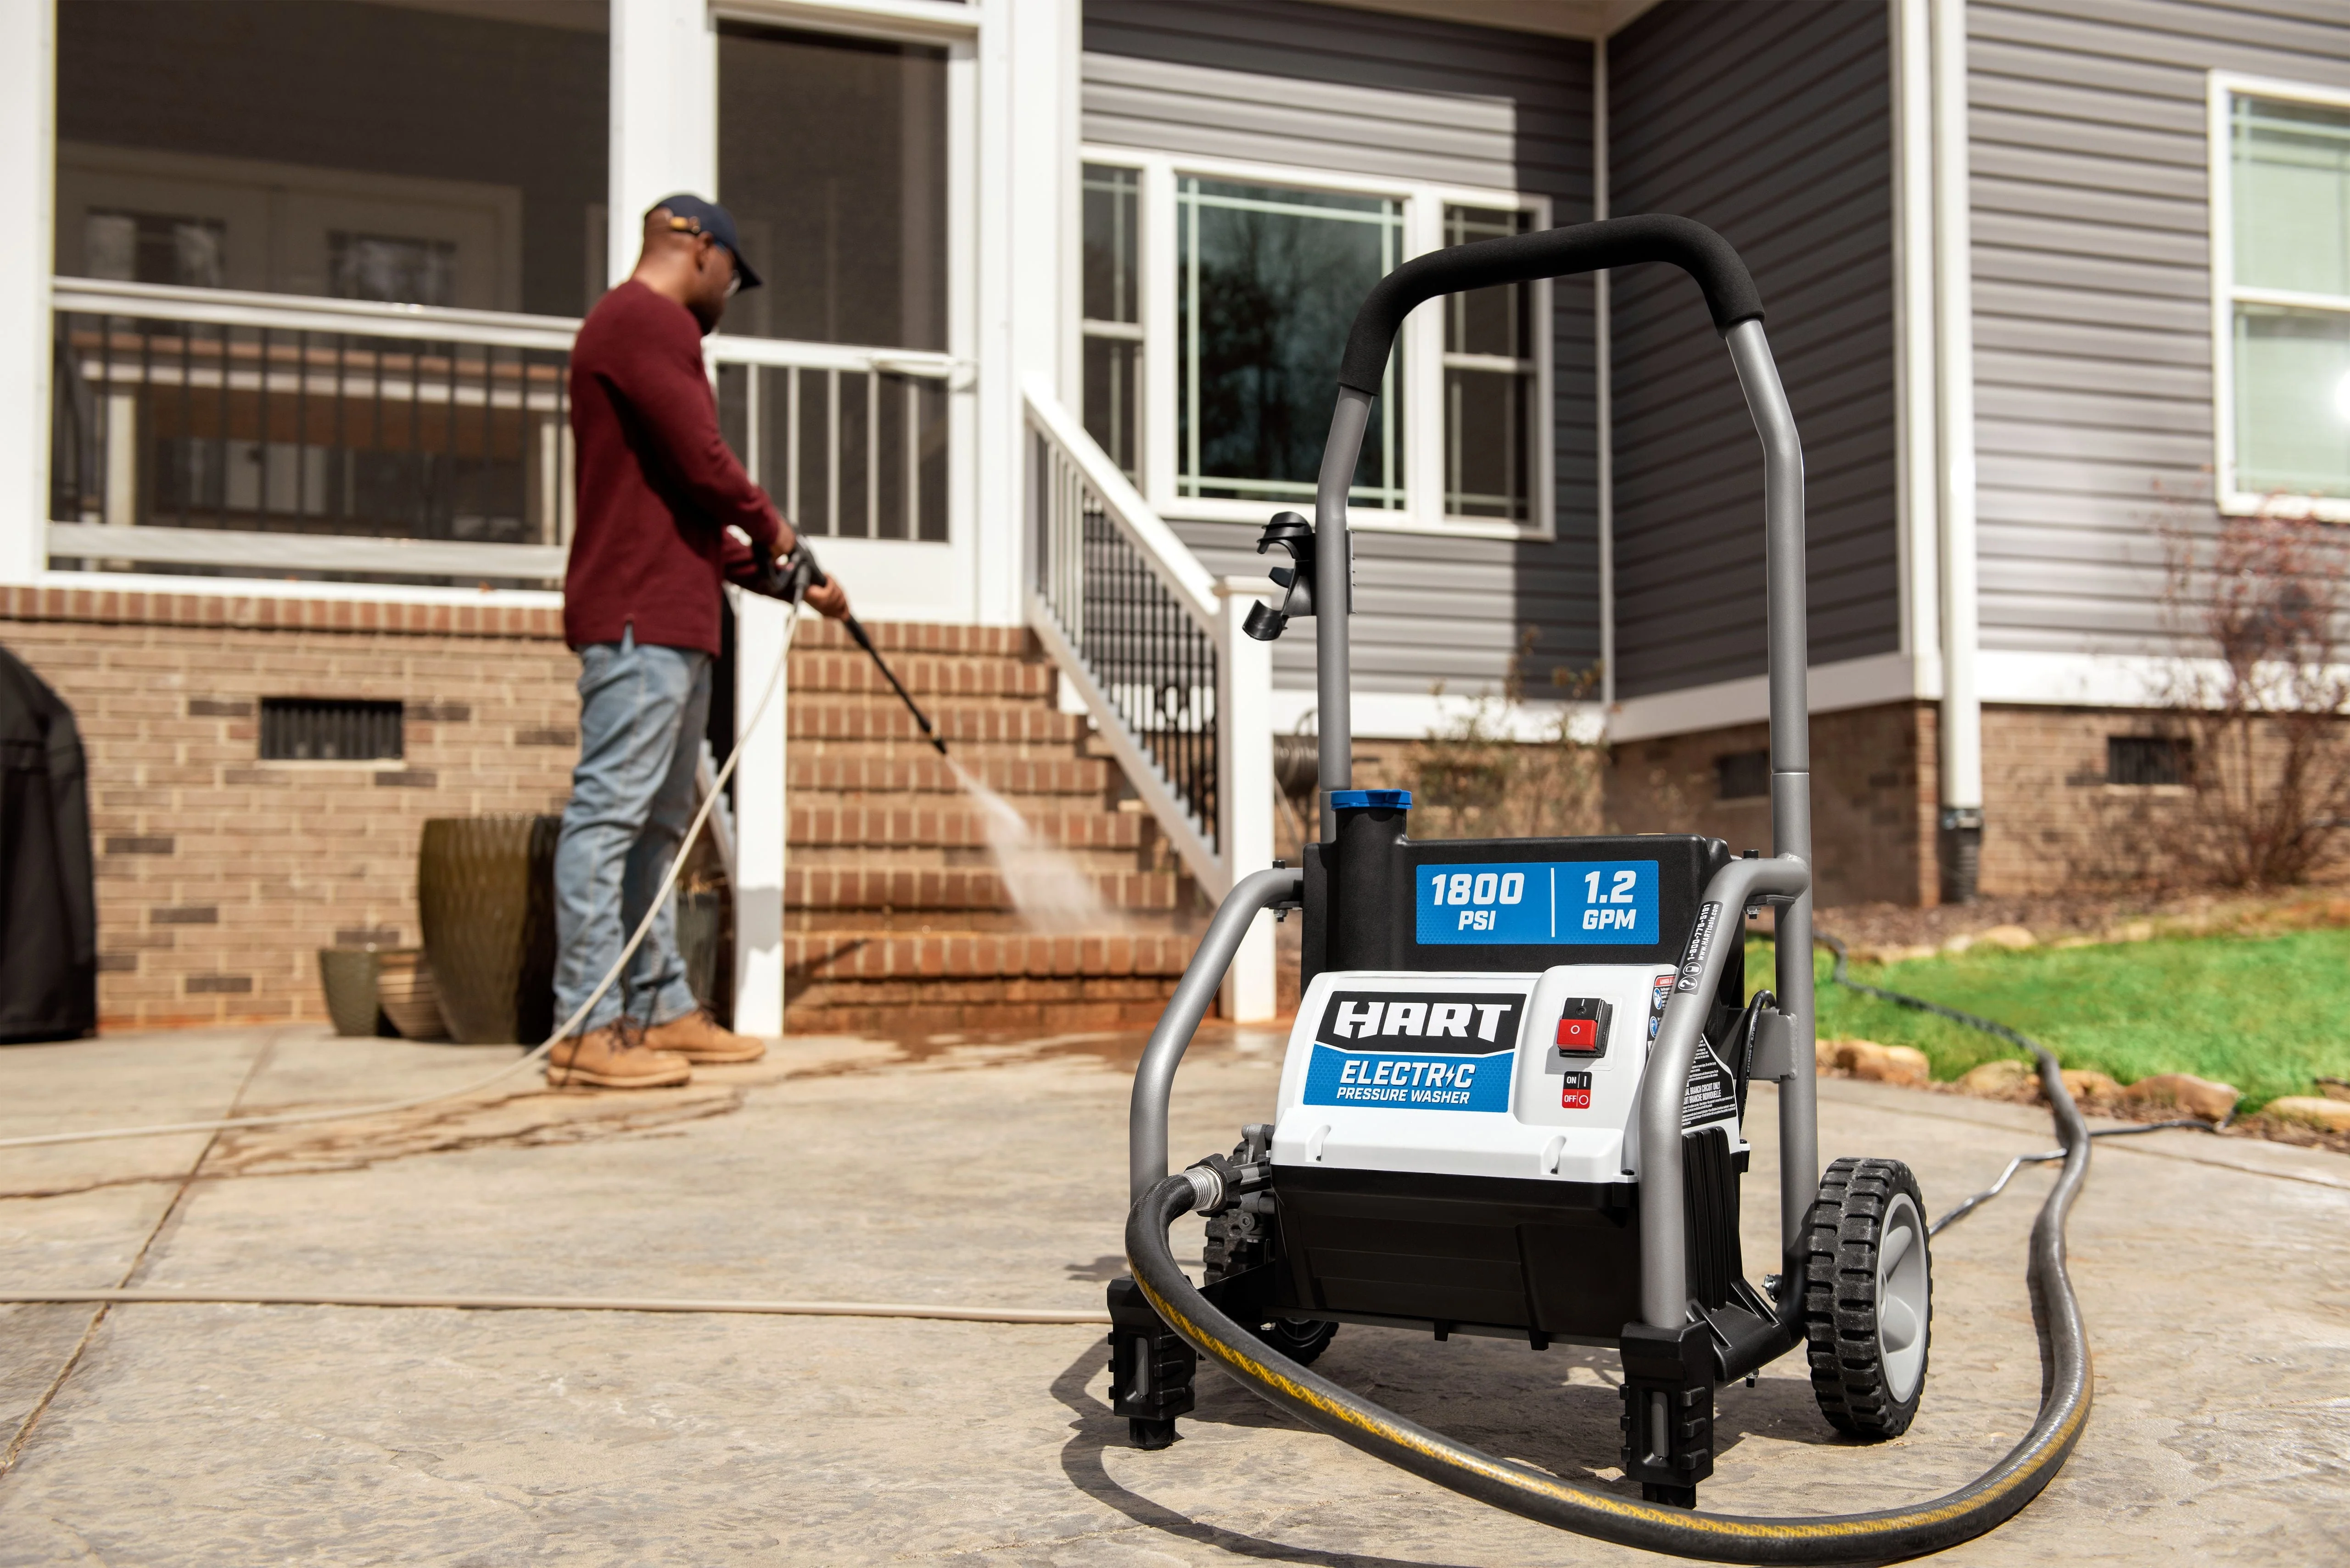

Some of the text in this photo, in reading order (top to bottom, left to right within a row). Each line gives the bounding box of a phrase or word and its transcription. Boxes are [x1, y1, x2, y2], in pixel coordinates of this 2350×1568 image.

[1432, 872, 1525, 905] 1800
[1584, 870, 1637, 904] 1.2
[1458, 910, 1496, 931] PSI
[1582, 909, 1637, 930] GPM
[1687, 904, 1711, 960] 1-800-776-5191
[1698, 904, 1720, 960] www.HARTtools.com
[1333, 1001, 1512, 1043] HART
[1337, 1087, 1471, 1105] PRESSURE WASHER
[1564, 1094, 1577, 1103] OFF
[1689, 1093, 1702, 1104] BRANCHE
[1702, 1089, 1721, 1101] INDIVIDUELLE
[1690, 1085, 1702, 1095] BRANCH
[1701, 1083, 1713, 1093] CIRCUIT
